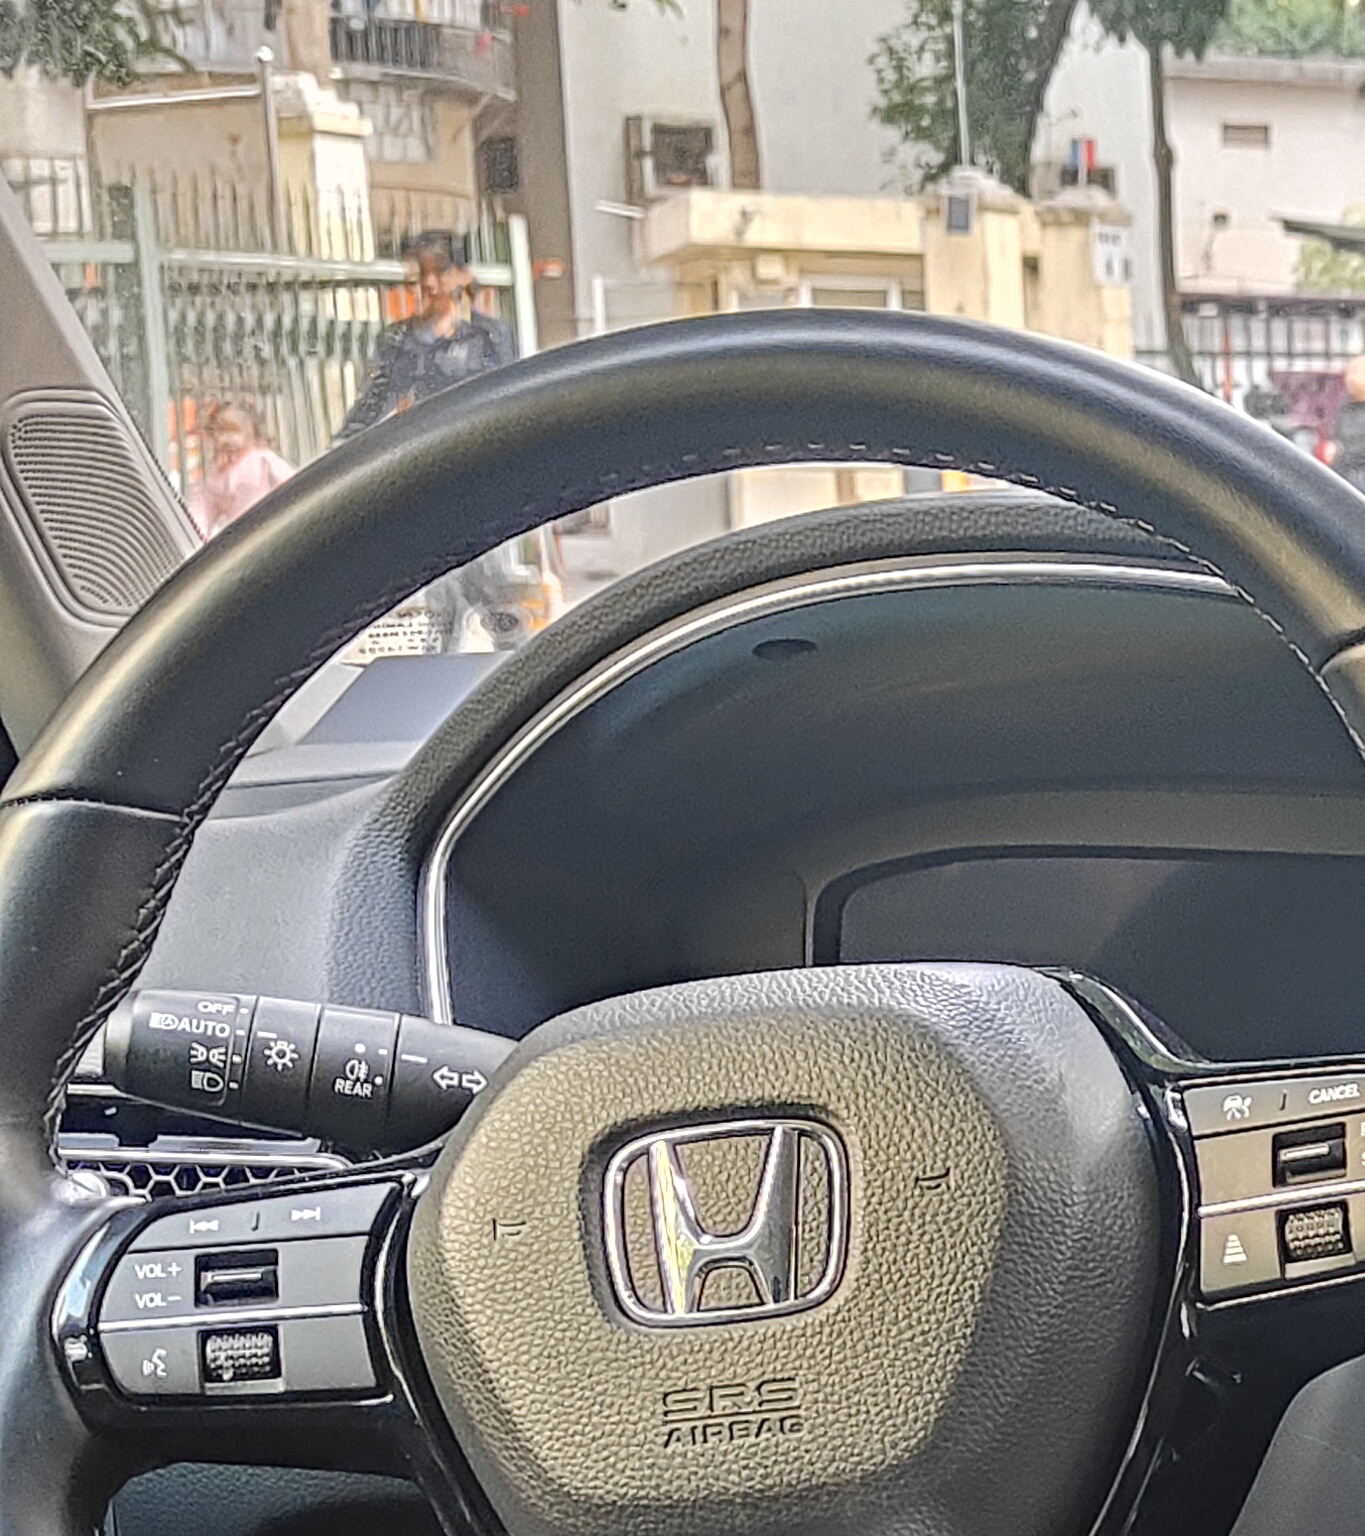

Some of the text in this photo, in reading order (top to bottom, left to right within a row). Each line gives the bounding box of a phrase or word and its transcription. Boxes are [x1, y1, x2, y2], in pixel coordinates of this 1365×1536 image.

[199, 1001, 235, 1014] OFF
[177, 1017, 230, 1037] AUTO
[335, 1077, 373, 1097] REAR
[1308, 1083, 1360, 1104] CANCEL
[661, 1377, 799, 1417] SRS
[662, 1414, 803, 1449] AIRBAG
